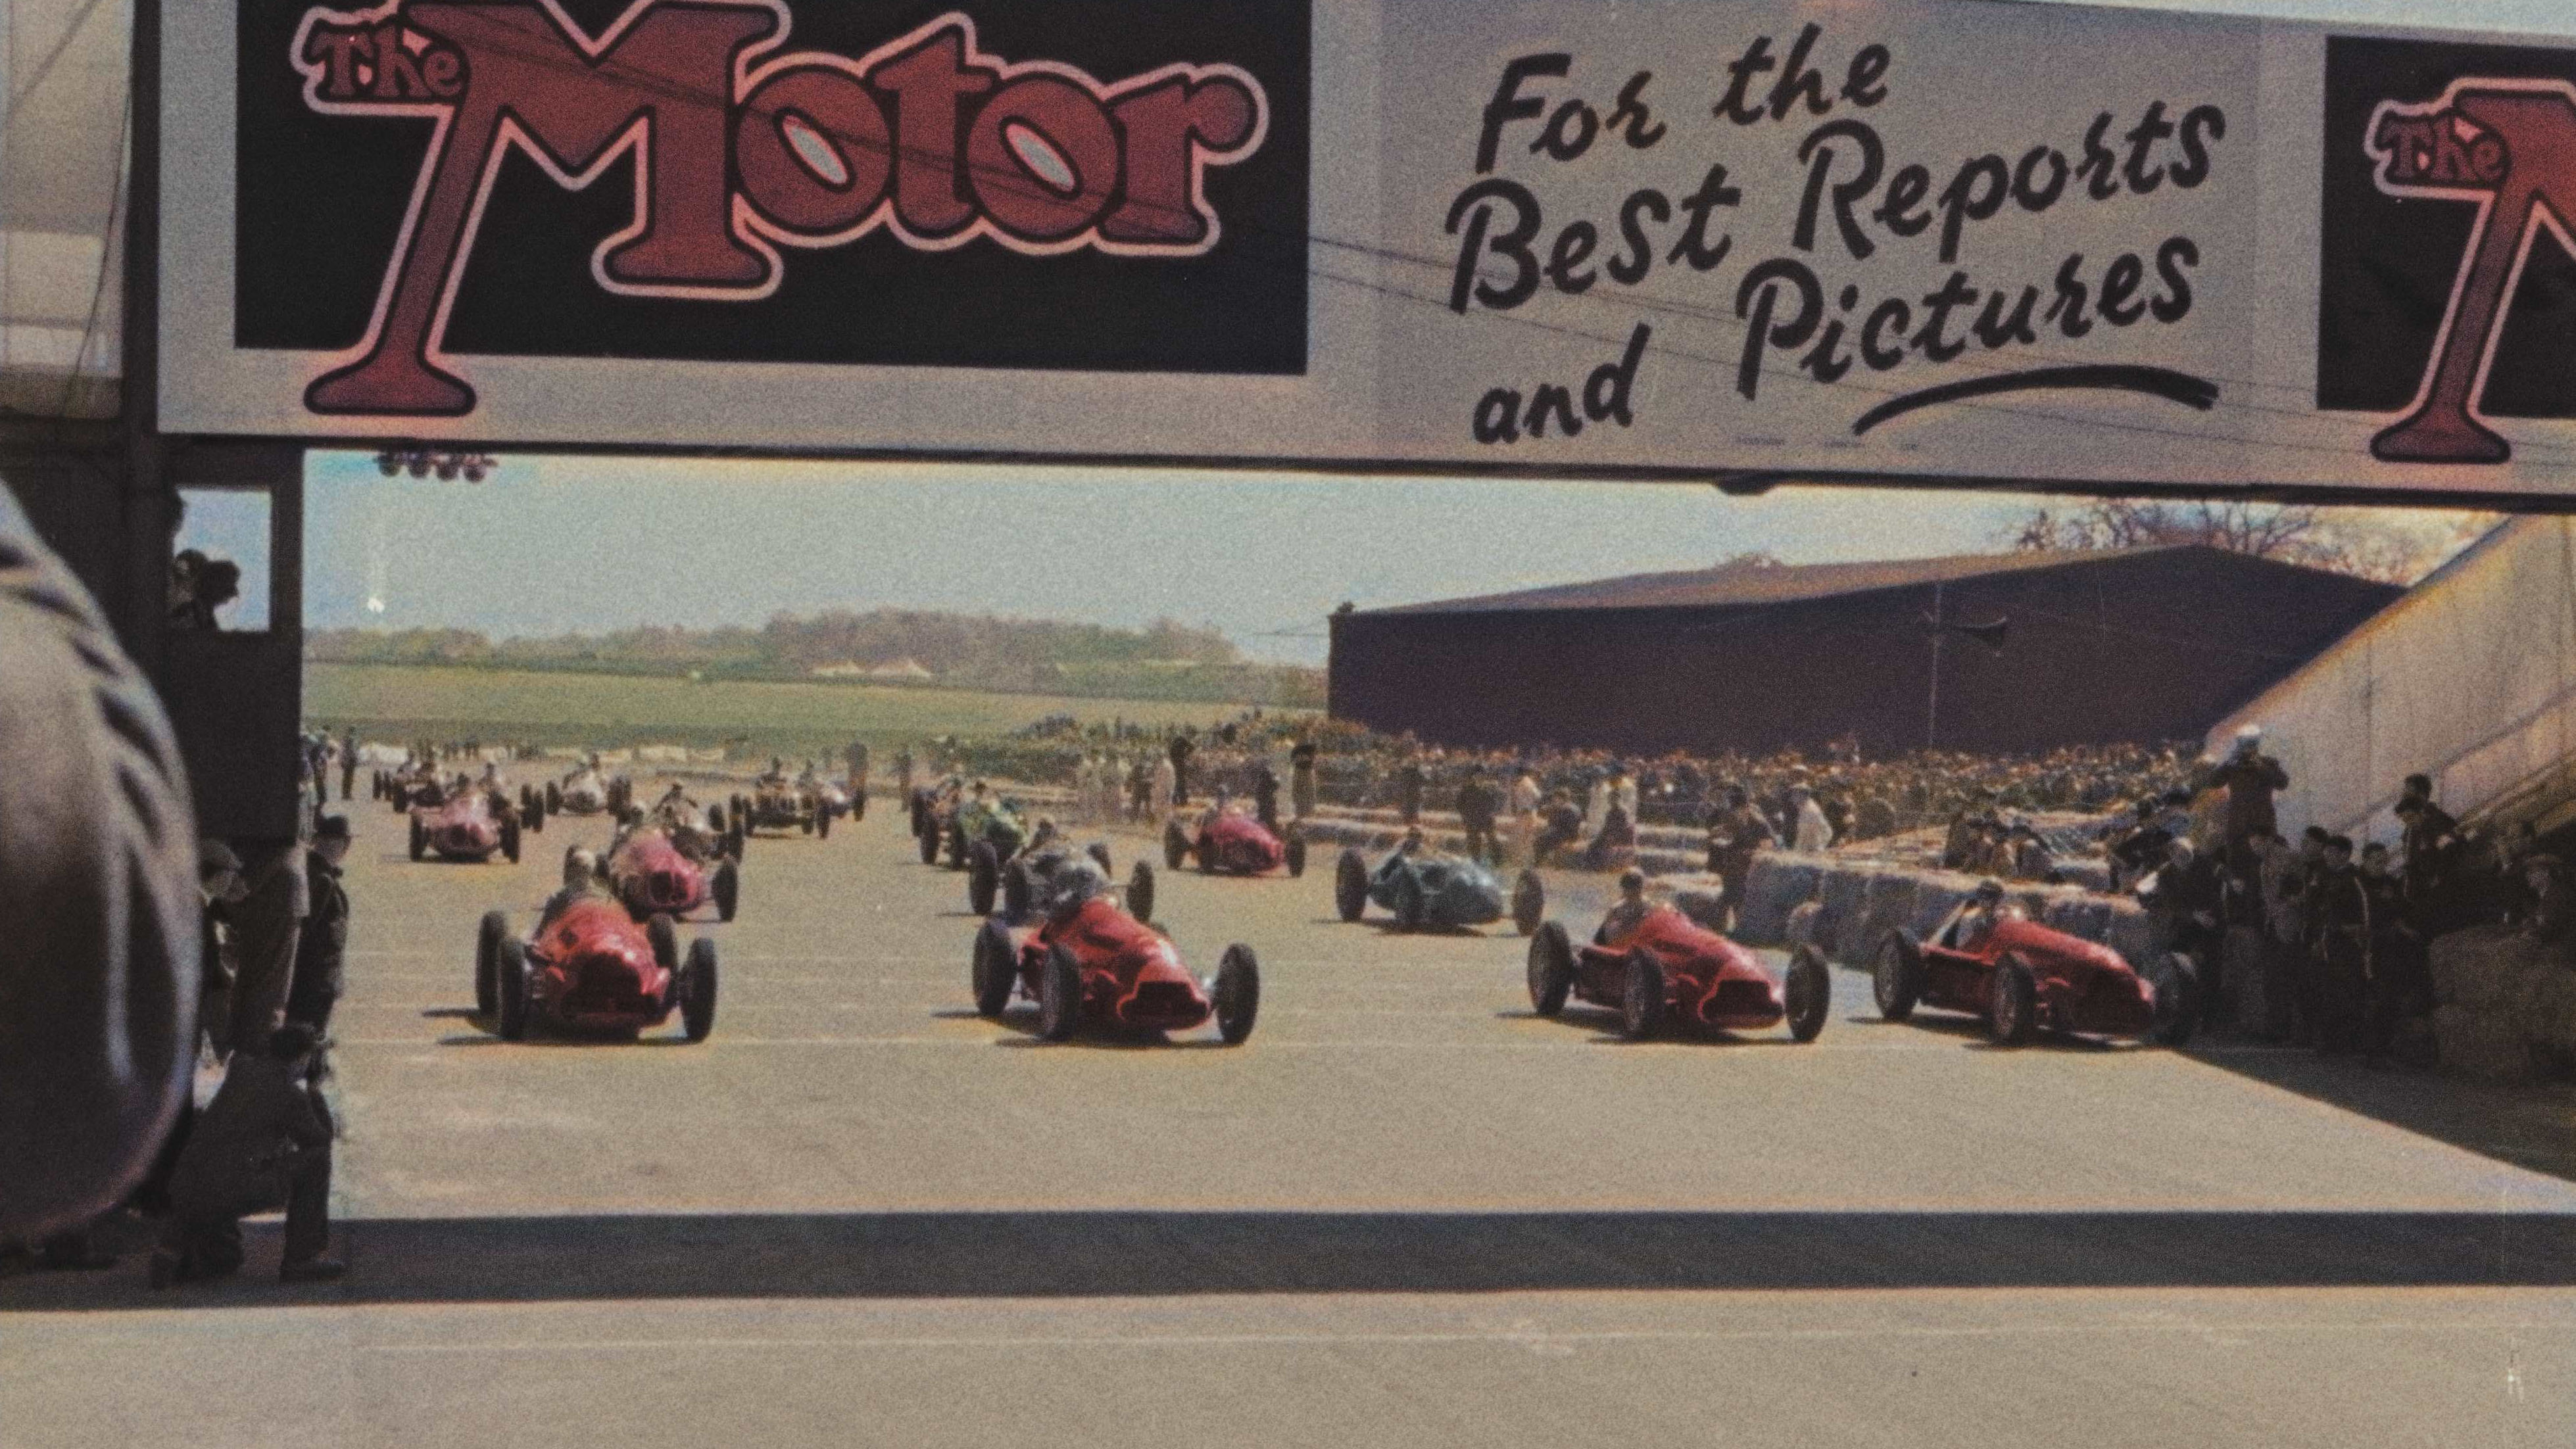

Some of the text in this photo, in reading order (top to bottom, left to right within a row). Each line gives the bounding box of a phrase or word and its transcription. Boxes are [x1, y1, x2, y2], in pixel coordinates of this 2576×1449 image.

[1474, 22, 1891, 174] For the
[2377, 108, 2508, 185] The
[303, 0, 1264, 417] The Motor
[1446, 101, 2226, 314] Best Reports
[1472, 236, 2200, 443] and Pictures
